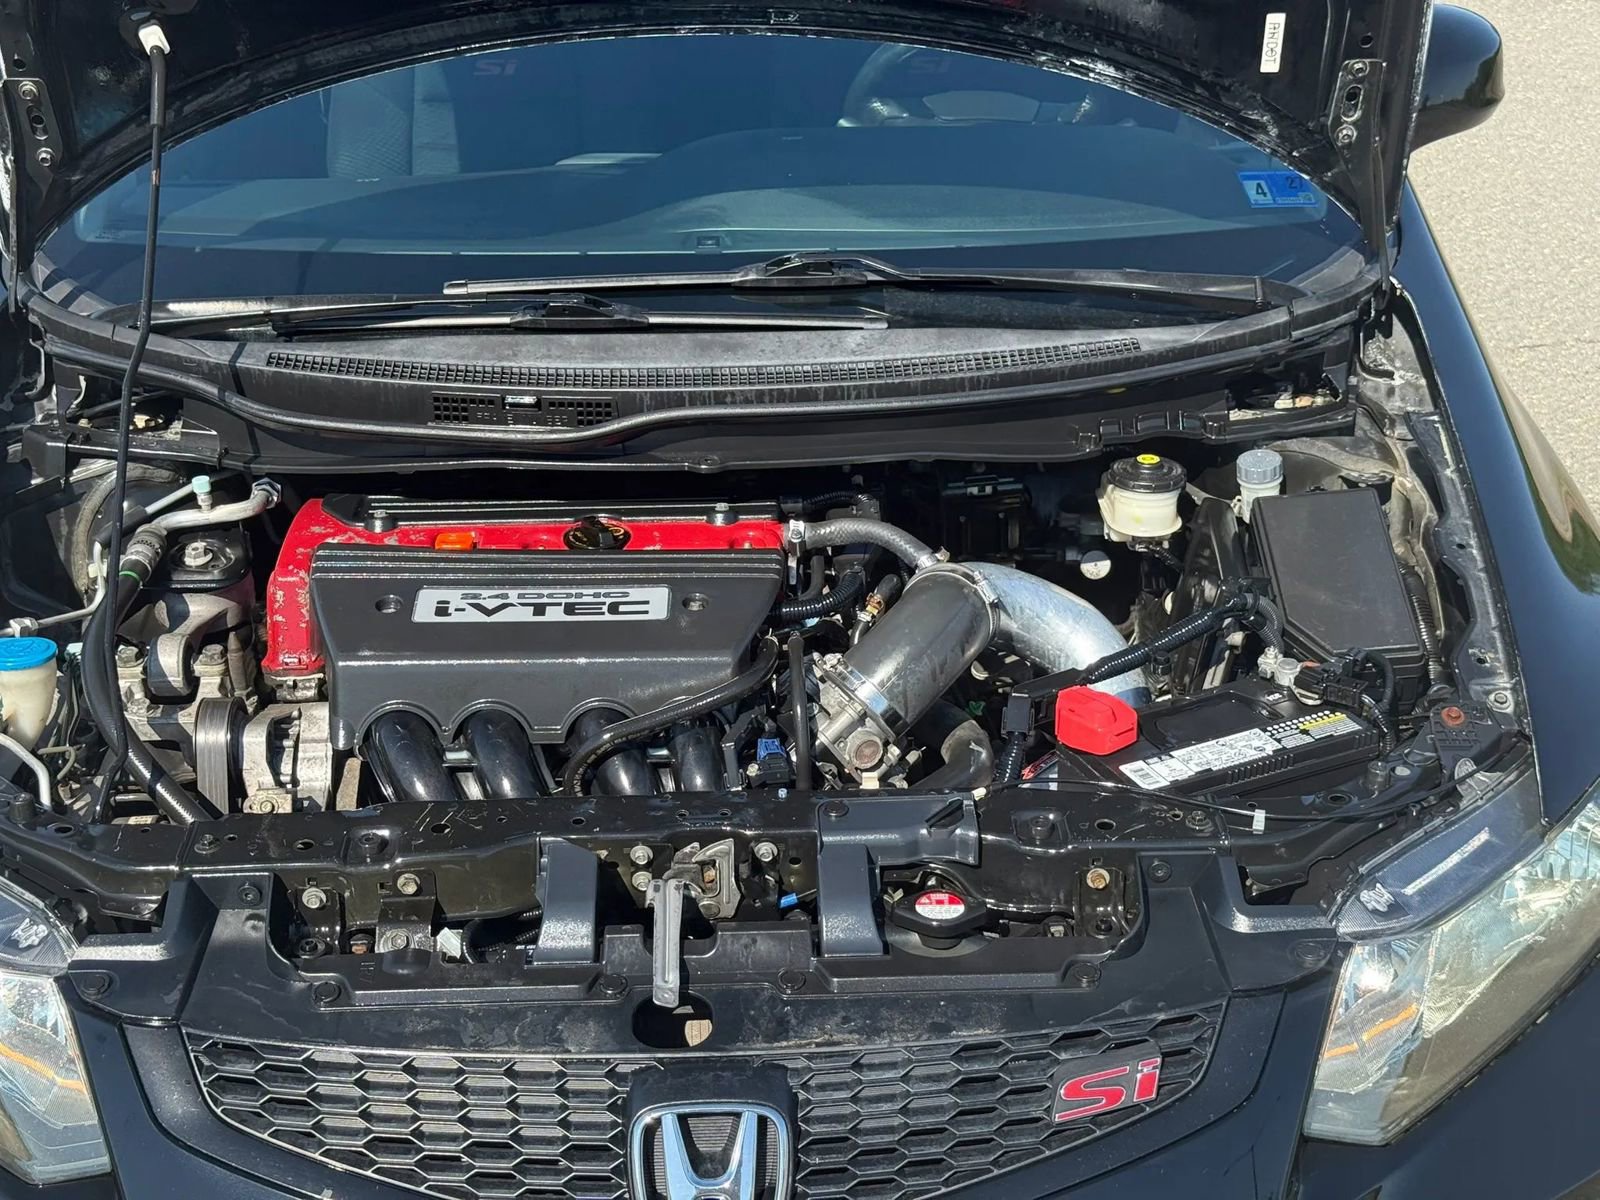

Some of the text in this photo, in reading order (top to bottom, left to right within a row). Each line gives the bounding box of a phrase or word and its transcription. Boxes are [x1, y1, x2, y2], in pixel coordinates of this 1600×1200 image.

[1255, 182, 1267, 197] 4
[460, 591, 630, 600] 2.4 DOHC
[434, 600, 650, 618] i-VTEC
[1054, 1057, 1161, 1122] Si
